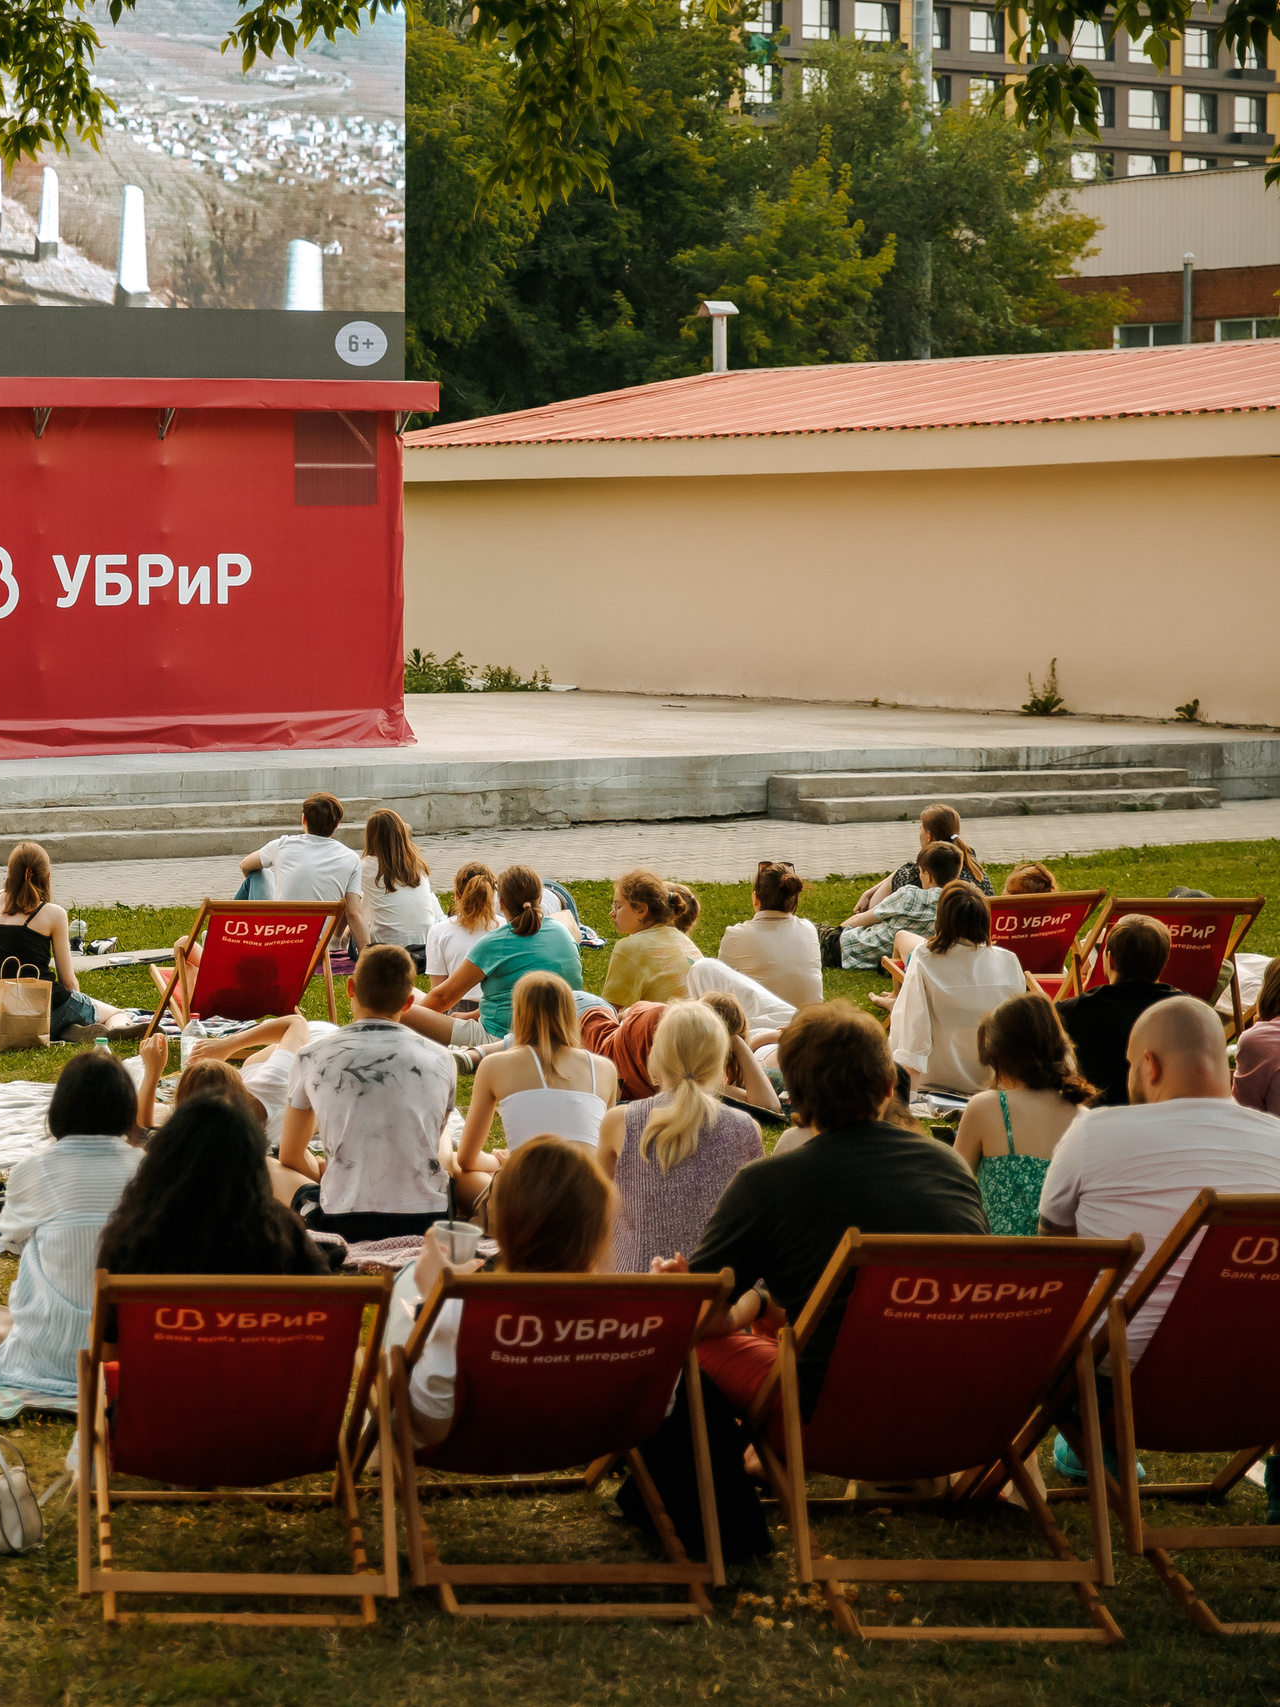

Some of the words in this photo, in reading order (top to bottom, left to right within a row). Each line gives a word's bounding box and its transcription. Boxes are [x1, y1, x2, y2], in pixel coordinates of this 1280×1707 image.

[348, 334, 374, 353] 6+
[51, 552, 253, 608] УБРиР
[1021, 912, 1072, 929] УБРиР
[253, 923, 309, 937] УБРиР
[1166, 924, 1216, 939] БРиР
[221, 935, 241, 944] Банк
[242, 939, 263, 947] моих
[264, 938, 304, 947] интересов
[1221, 1268, 1257, 1280] Банк
[949, 1280, 1064, 1303] УБРиР
[215, 1311, 328, 1329] УБРиР
[883, 1308, 921, 1319] Банк
[926, 1313, 965, 1321] моих
[969, 1307, 1053, 1321] интересов
[154, 1332, 192, 1342] Банк
[554, 1315, 664, 1343] УБРиР
[491, 1350, 528, 1364] Банк
[533, 1354, 571, 1364] моих
[575, 1347, 656, 1363] интересов
